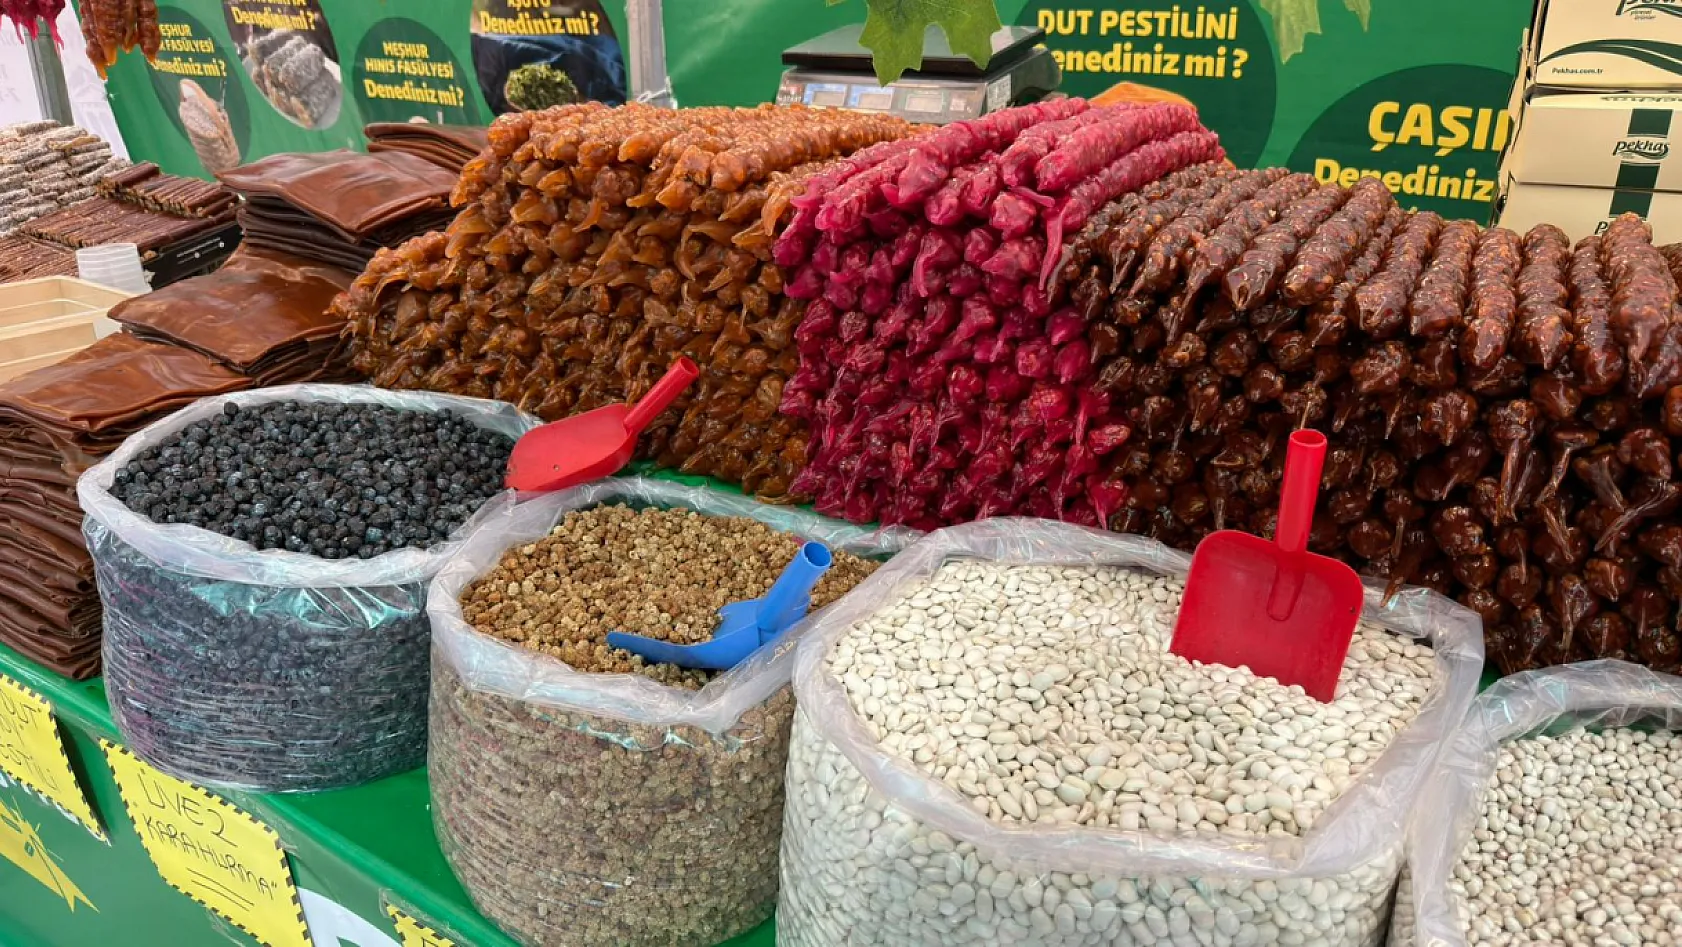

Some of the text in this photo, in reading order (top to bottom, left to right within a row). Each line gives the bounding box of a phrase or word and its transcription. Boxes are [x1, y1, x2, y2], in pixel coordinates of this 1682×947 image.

[158, 24, 192, 38] EŞHUR
[480, 10, 599, 36] Denediniz mi ?
[1037, 4, 1238, 40] DUT PESTİLİNİ
[383, 41, 430, 59] MEŞHUR
[1034, 43, 1248, 78] enediniz mi ?
[153, 57, 204, 75] enediniz
[365, 57, 454, 79] HINIS FASÜLYESİ
[364, 79, 464, 107] Denediniz mi ?
